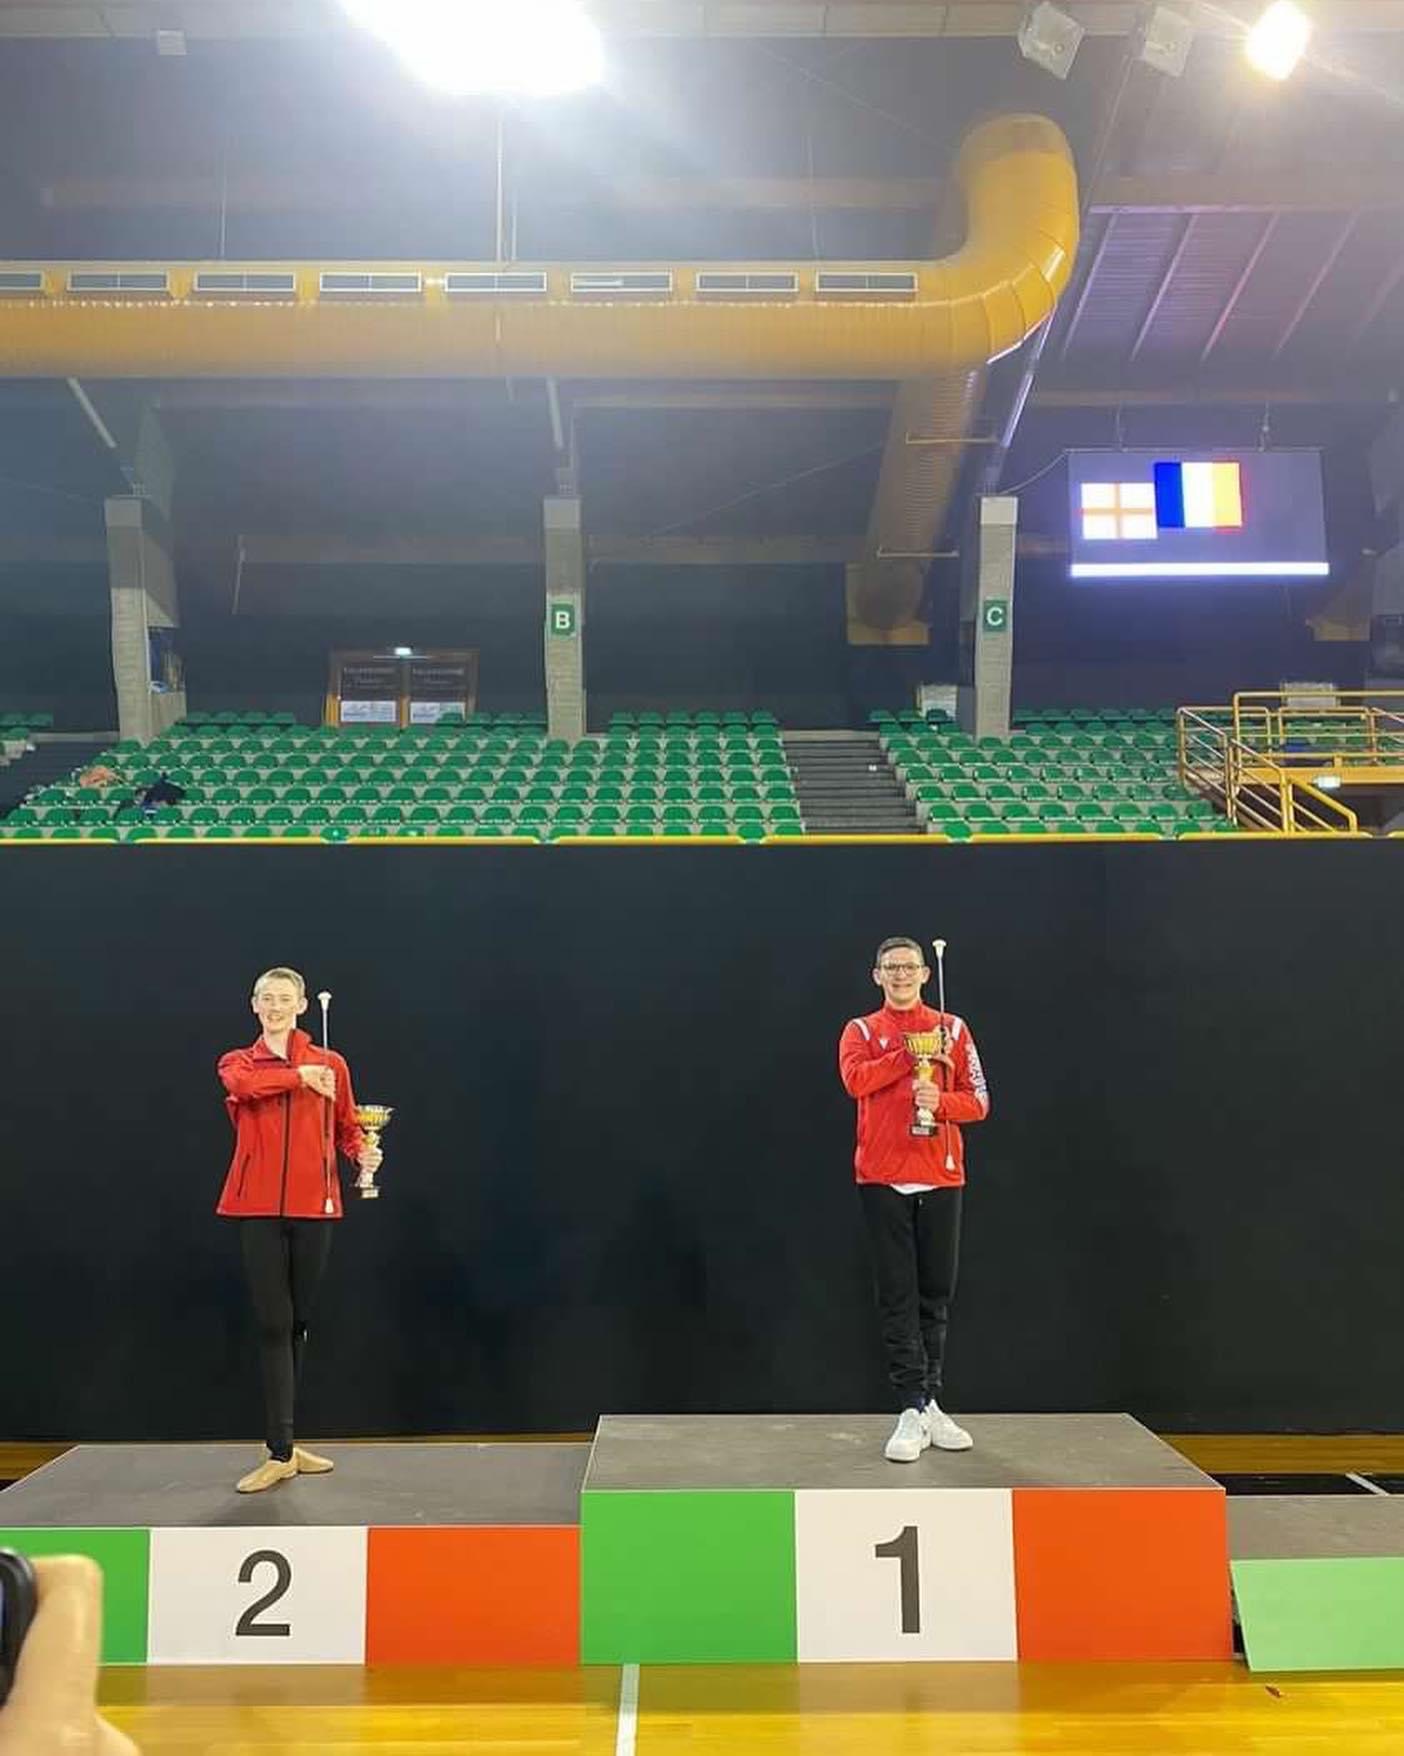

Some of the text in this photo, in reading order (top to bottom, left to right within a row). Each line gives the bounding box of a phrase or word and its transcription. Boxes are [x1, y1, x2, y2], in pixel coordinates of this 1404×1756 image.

[556, 611, 570, 629] B
[987, 607, 1002, 625] C
[235, 1549, 292, 1636] 2
[875, 1525, 920, 1633] 1
